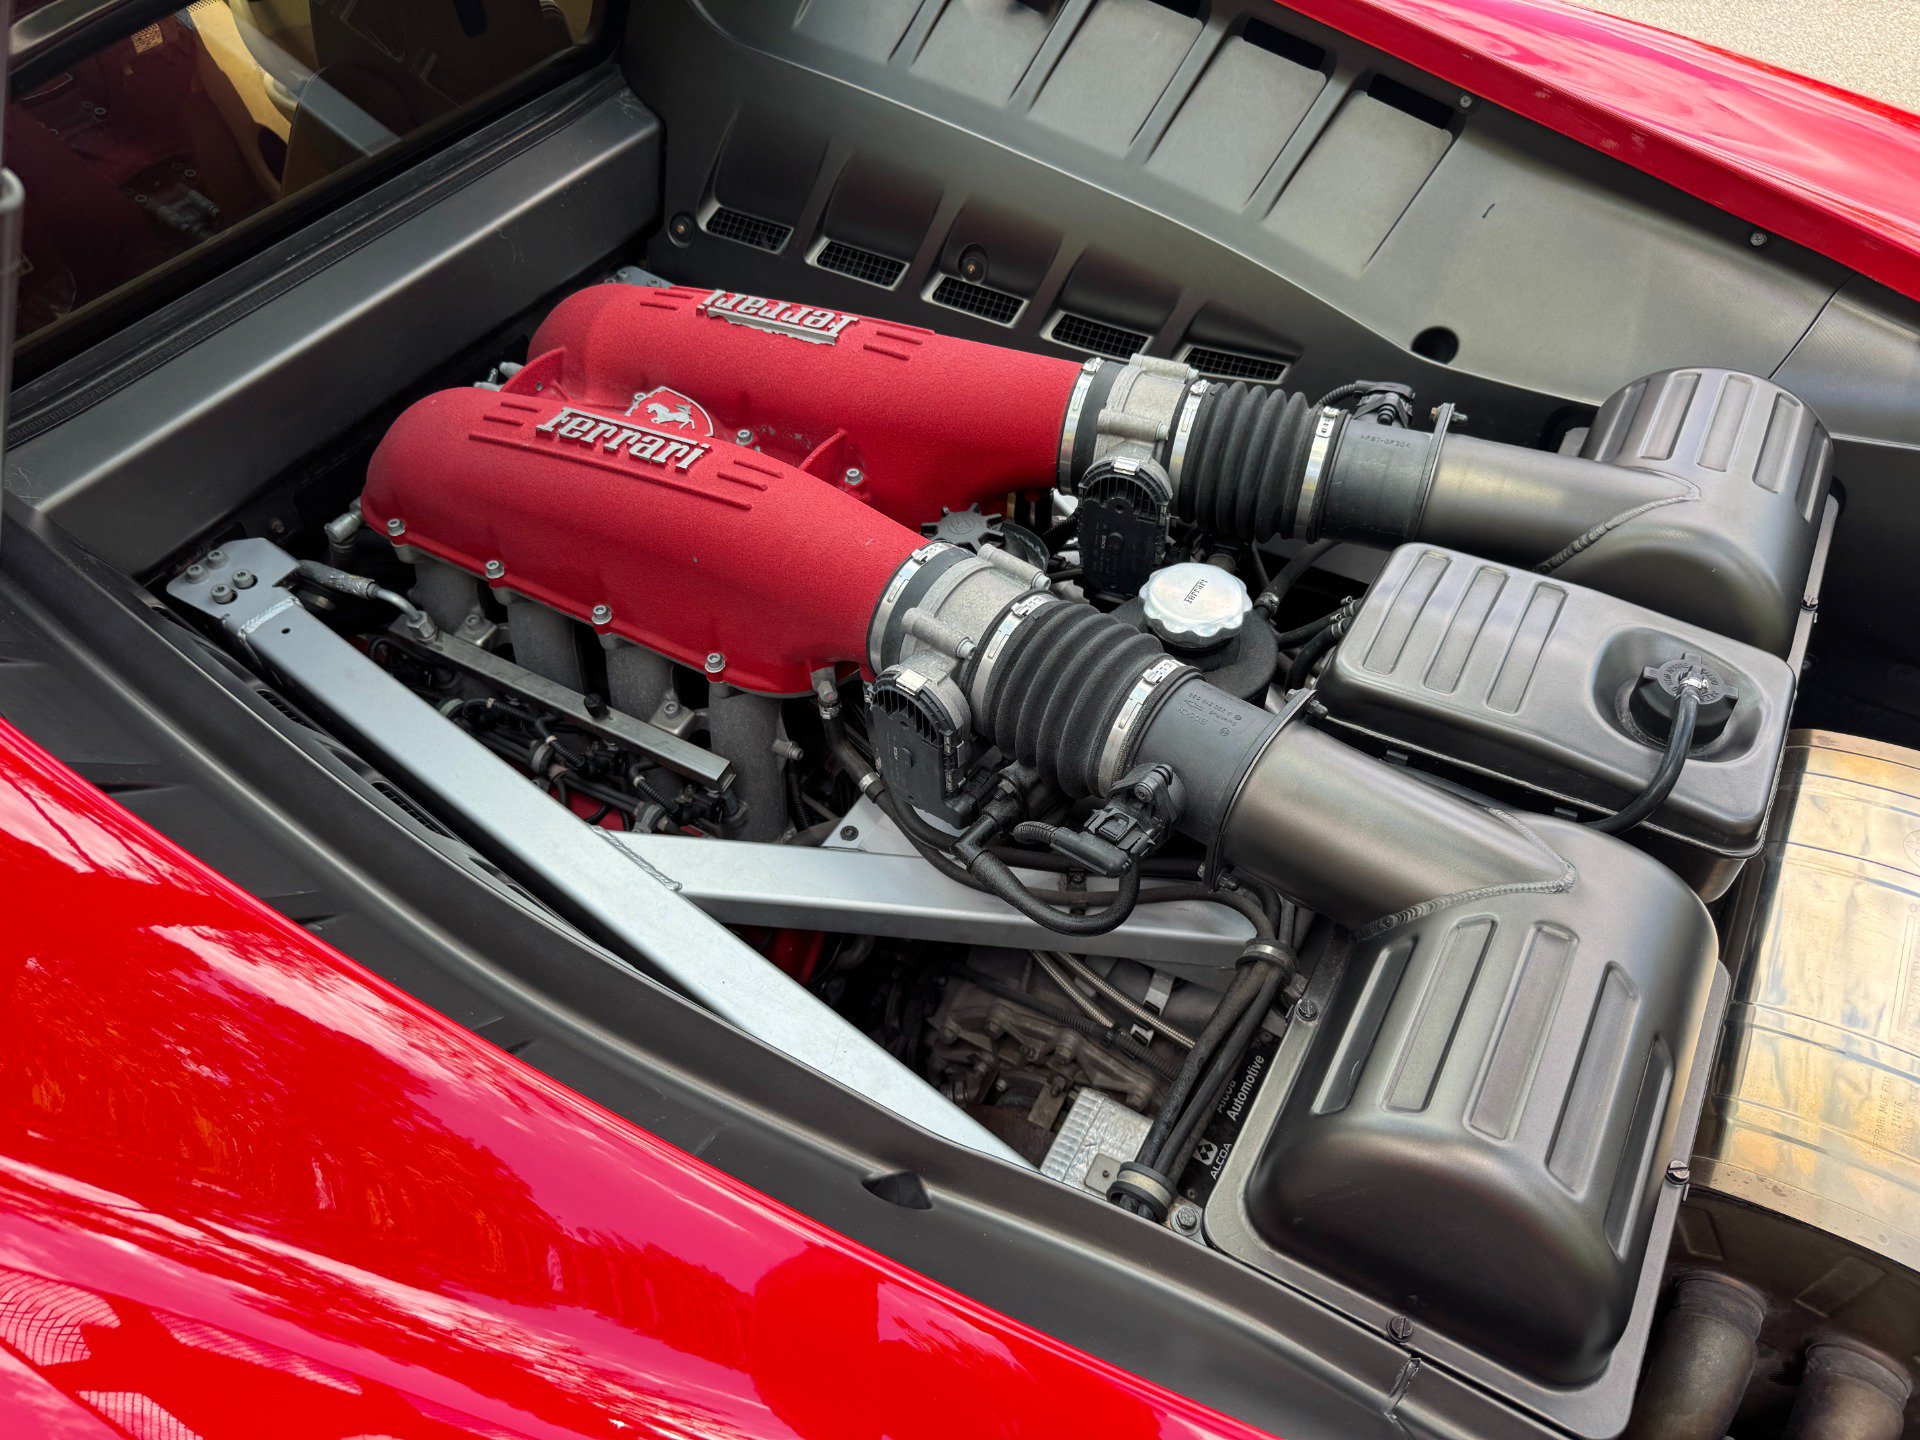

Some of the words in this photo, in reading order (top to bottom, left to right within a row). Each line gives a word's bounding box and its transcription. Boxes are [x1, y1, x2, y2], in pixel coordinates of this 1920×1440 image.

[699, 289, 859, 344] Ferrari
[536, 406, 711, 473] Ferrari
[1226, 1054, 1265, 1122] Automotive
[1209, 1143, 1232, 1181] ALCOA
